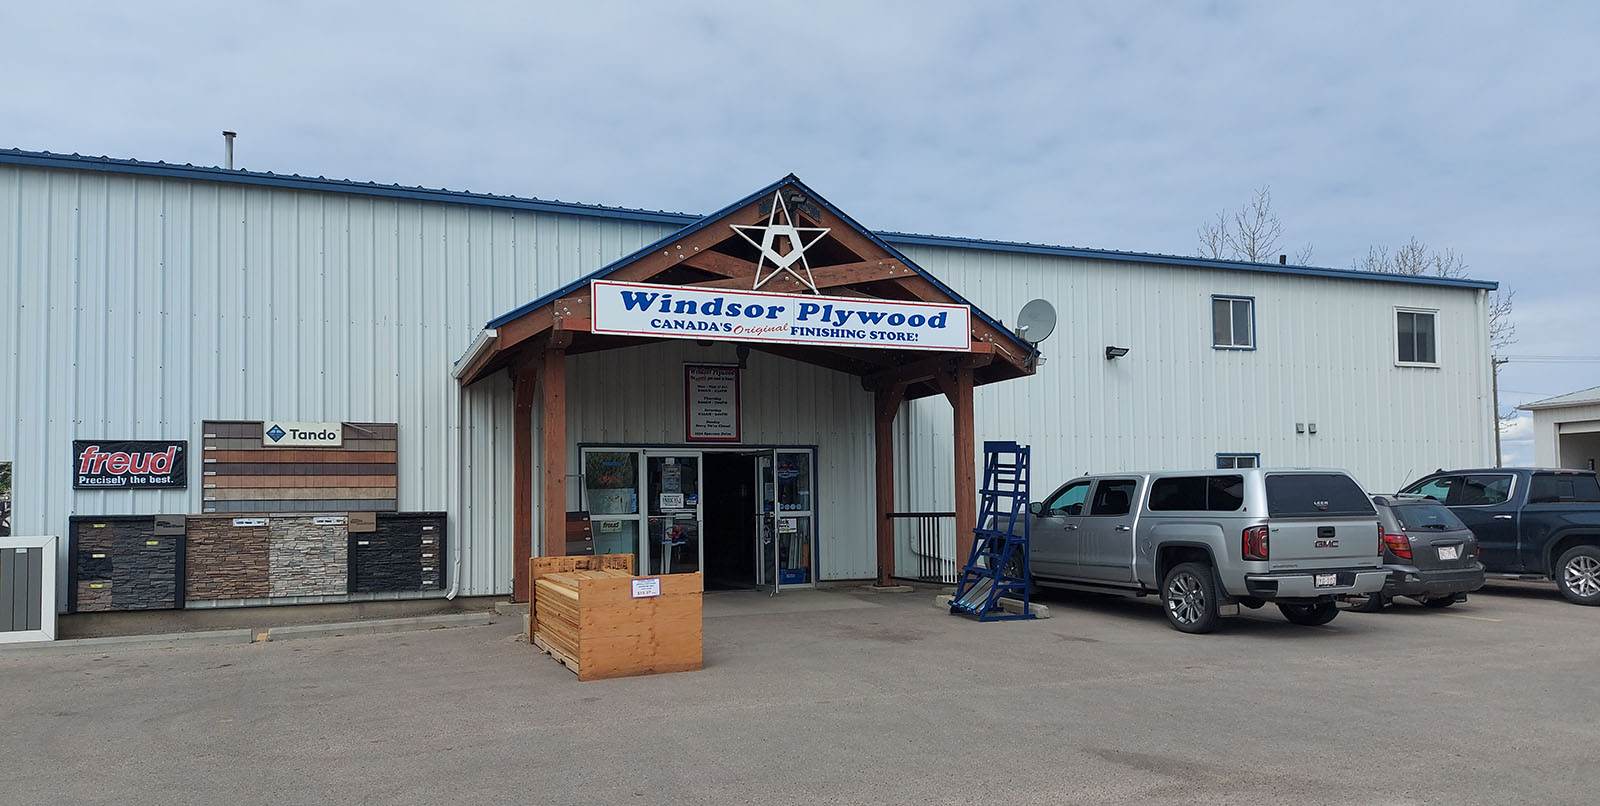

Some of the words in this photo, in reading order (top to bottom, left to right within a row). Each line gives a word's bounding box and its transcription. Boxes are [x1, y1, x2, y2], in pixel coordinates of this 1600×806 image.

[620, 290, 785, 319] Windsor
[797, 302, 948, 329] Plywood
[651, 318, 732, 332] CANADA'S
[733, 323, 788, 336] Original
[791, 326, 866, 339] FINISHING
[870, 331, 919, 342] STORE!
[289, 429, 336, 440] Tando
[79, 445, 177, 475] freud
[79, 476, 127, 486] Precisely
[130, 476, 146, 484] the
[150, 476, 174, 484] best.
[1314, 540, 1339, 548] GMC
